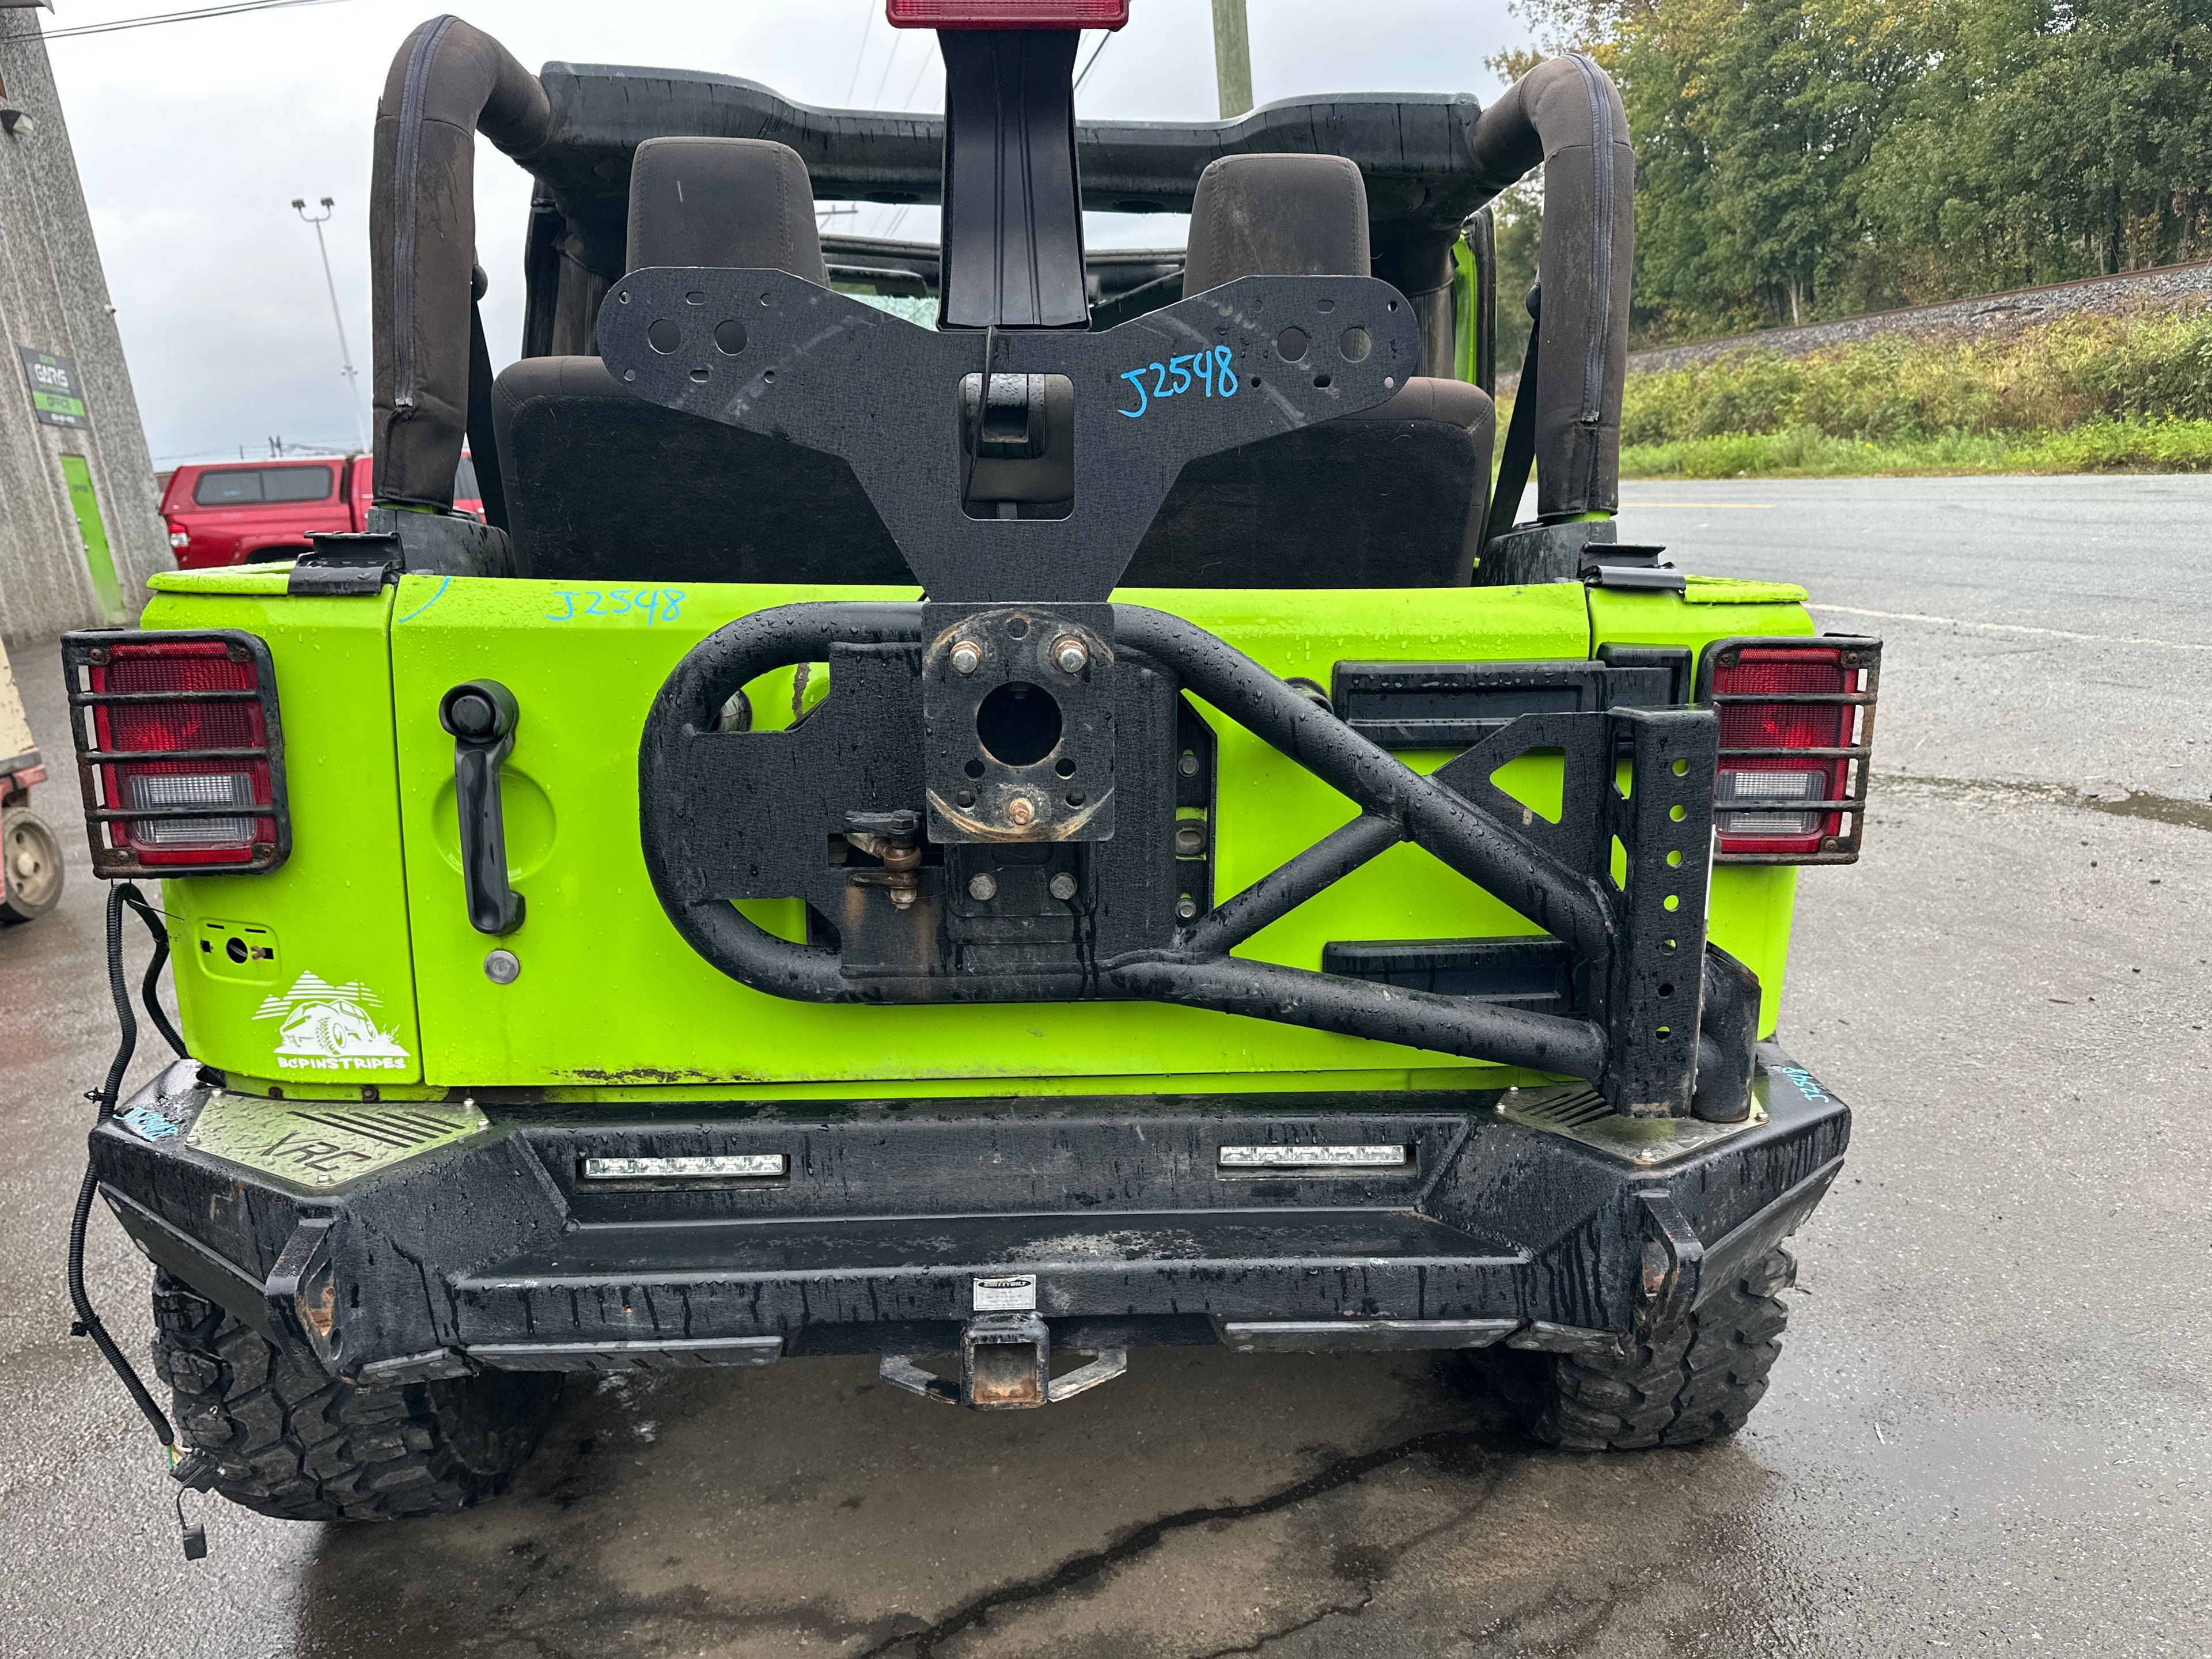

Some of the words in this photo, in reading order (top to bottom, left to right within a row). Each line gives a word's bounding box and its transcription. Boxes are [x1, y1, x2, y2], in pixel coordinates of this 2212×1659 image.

[1118, 345, 1238, 418] J2548
[545, 588, 686, 626] J2548
[277, 1056, 407, 1070] BCPINSTRIPES
